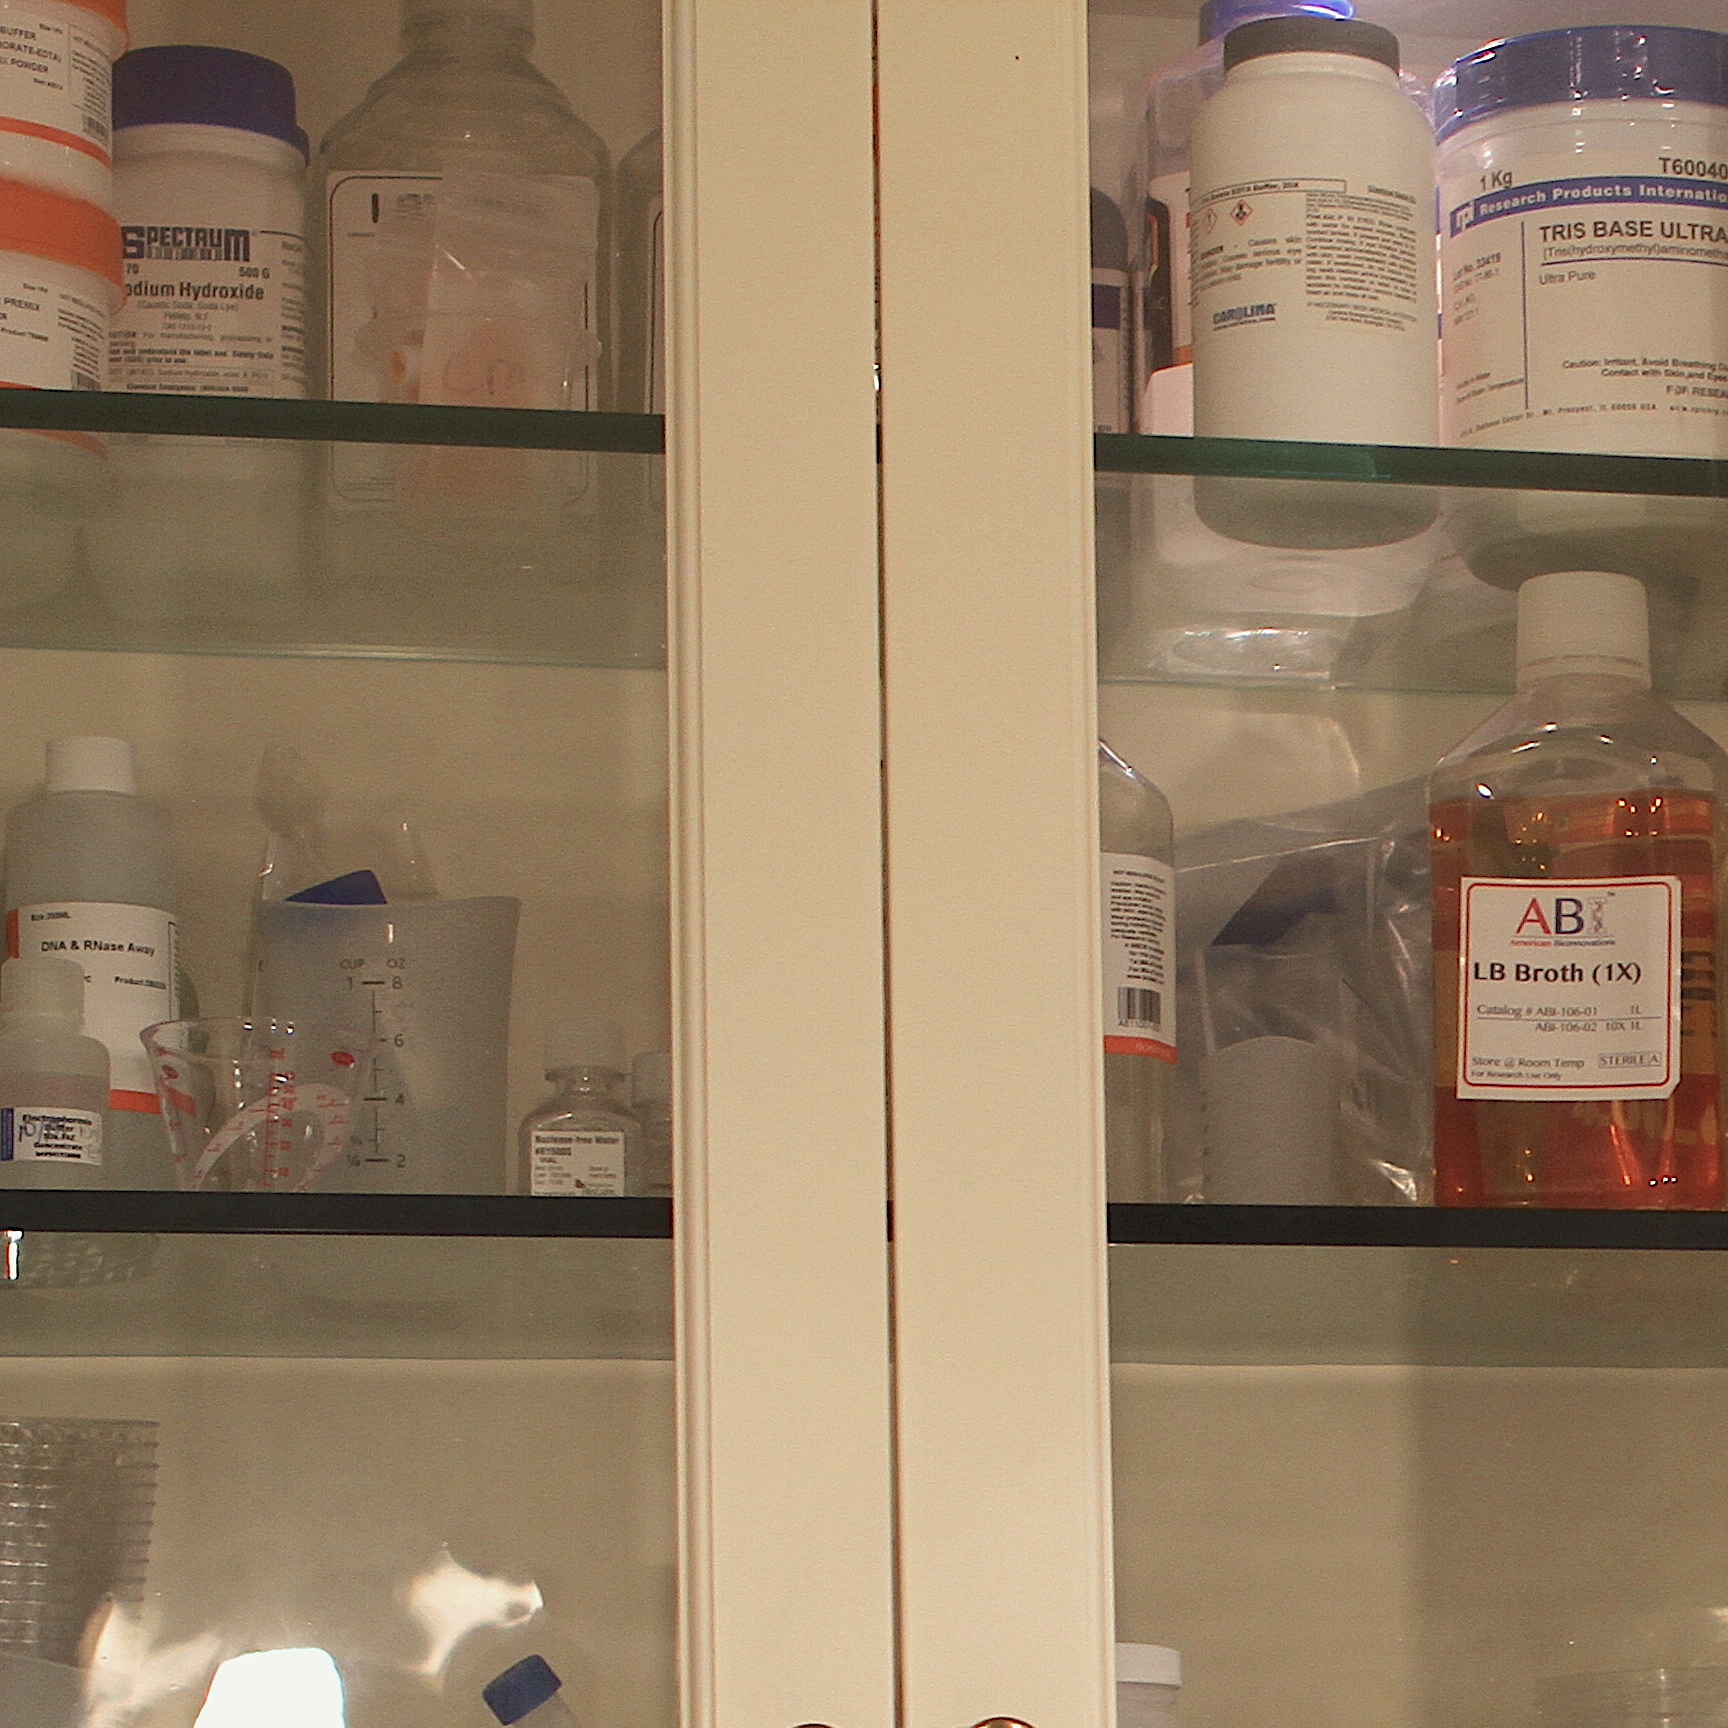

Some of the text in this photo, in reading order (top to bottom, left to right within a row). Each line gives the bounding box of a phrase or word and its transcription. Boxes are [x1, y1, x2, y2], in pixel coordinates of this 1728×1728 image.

[1480, 169, 1513, 191] 1 Kg
[1478, 191, 1546, 216] Research
[1552, 184, 1632, 201] Products
[1539, 222, 1586, 243] TRIS
[1592, 220, 1654, 238] BASE
[1539, 270, 1596, 286] Ultra Pure
[125, 280, 264, 301] odium Hydroxide
[1601, 368, 1639, 377] Contact
[1641, 368, 1662, 377] with
[41, 940, 156, 957] DNA & RNase Away
[339, 957, 406, 970] CUP OZ
[1474, 961, 1642, 986] LB Broth (1X)
[392, 975, 402, 990] 8
[1476, 1004, 1522, 1018] Catalog
[394, 1033, 404, 1048] 6
[1471, 1056, 1500, 1067] Store
[1517, 1057, 1552, 1068] Room
[1554, 1057, 1586, 1070] Temp
[397, 1154, 406, 1168] 2
